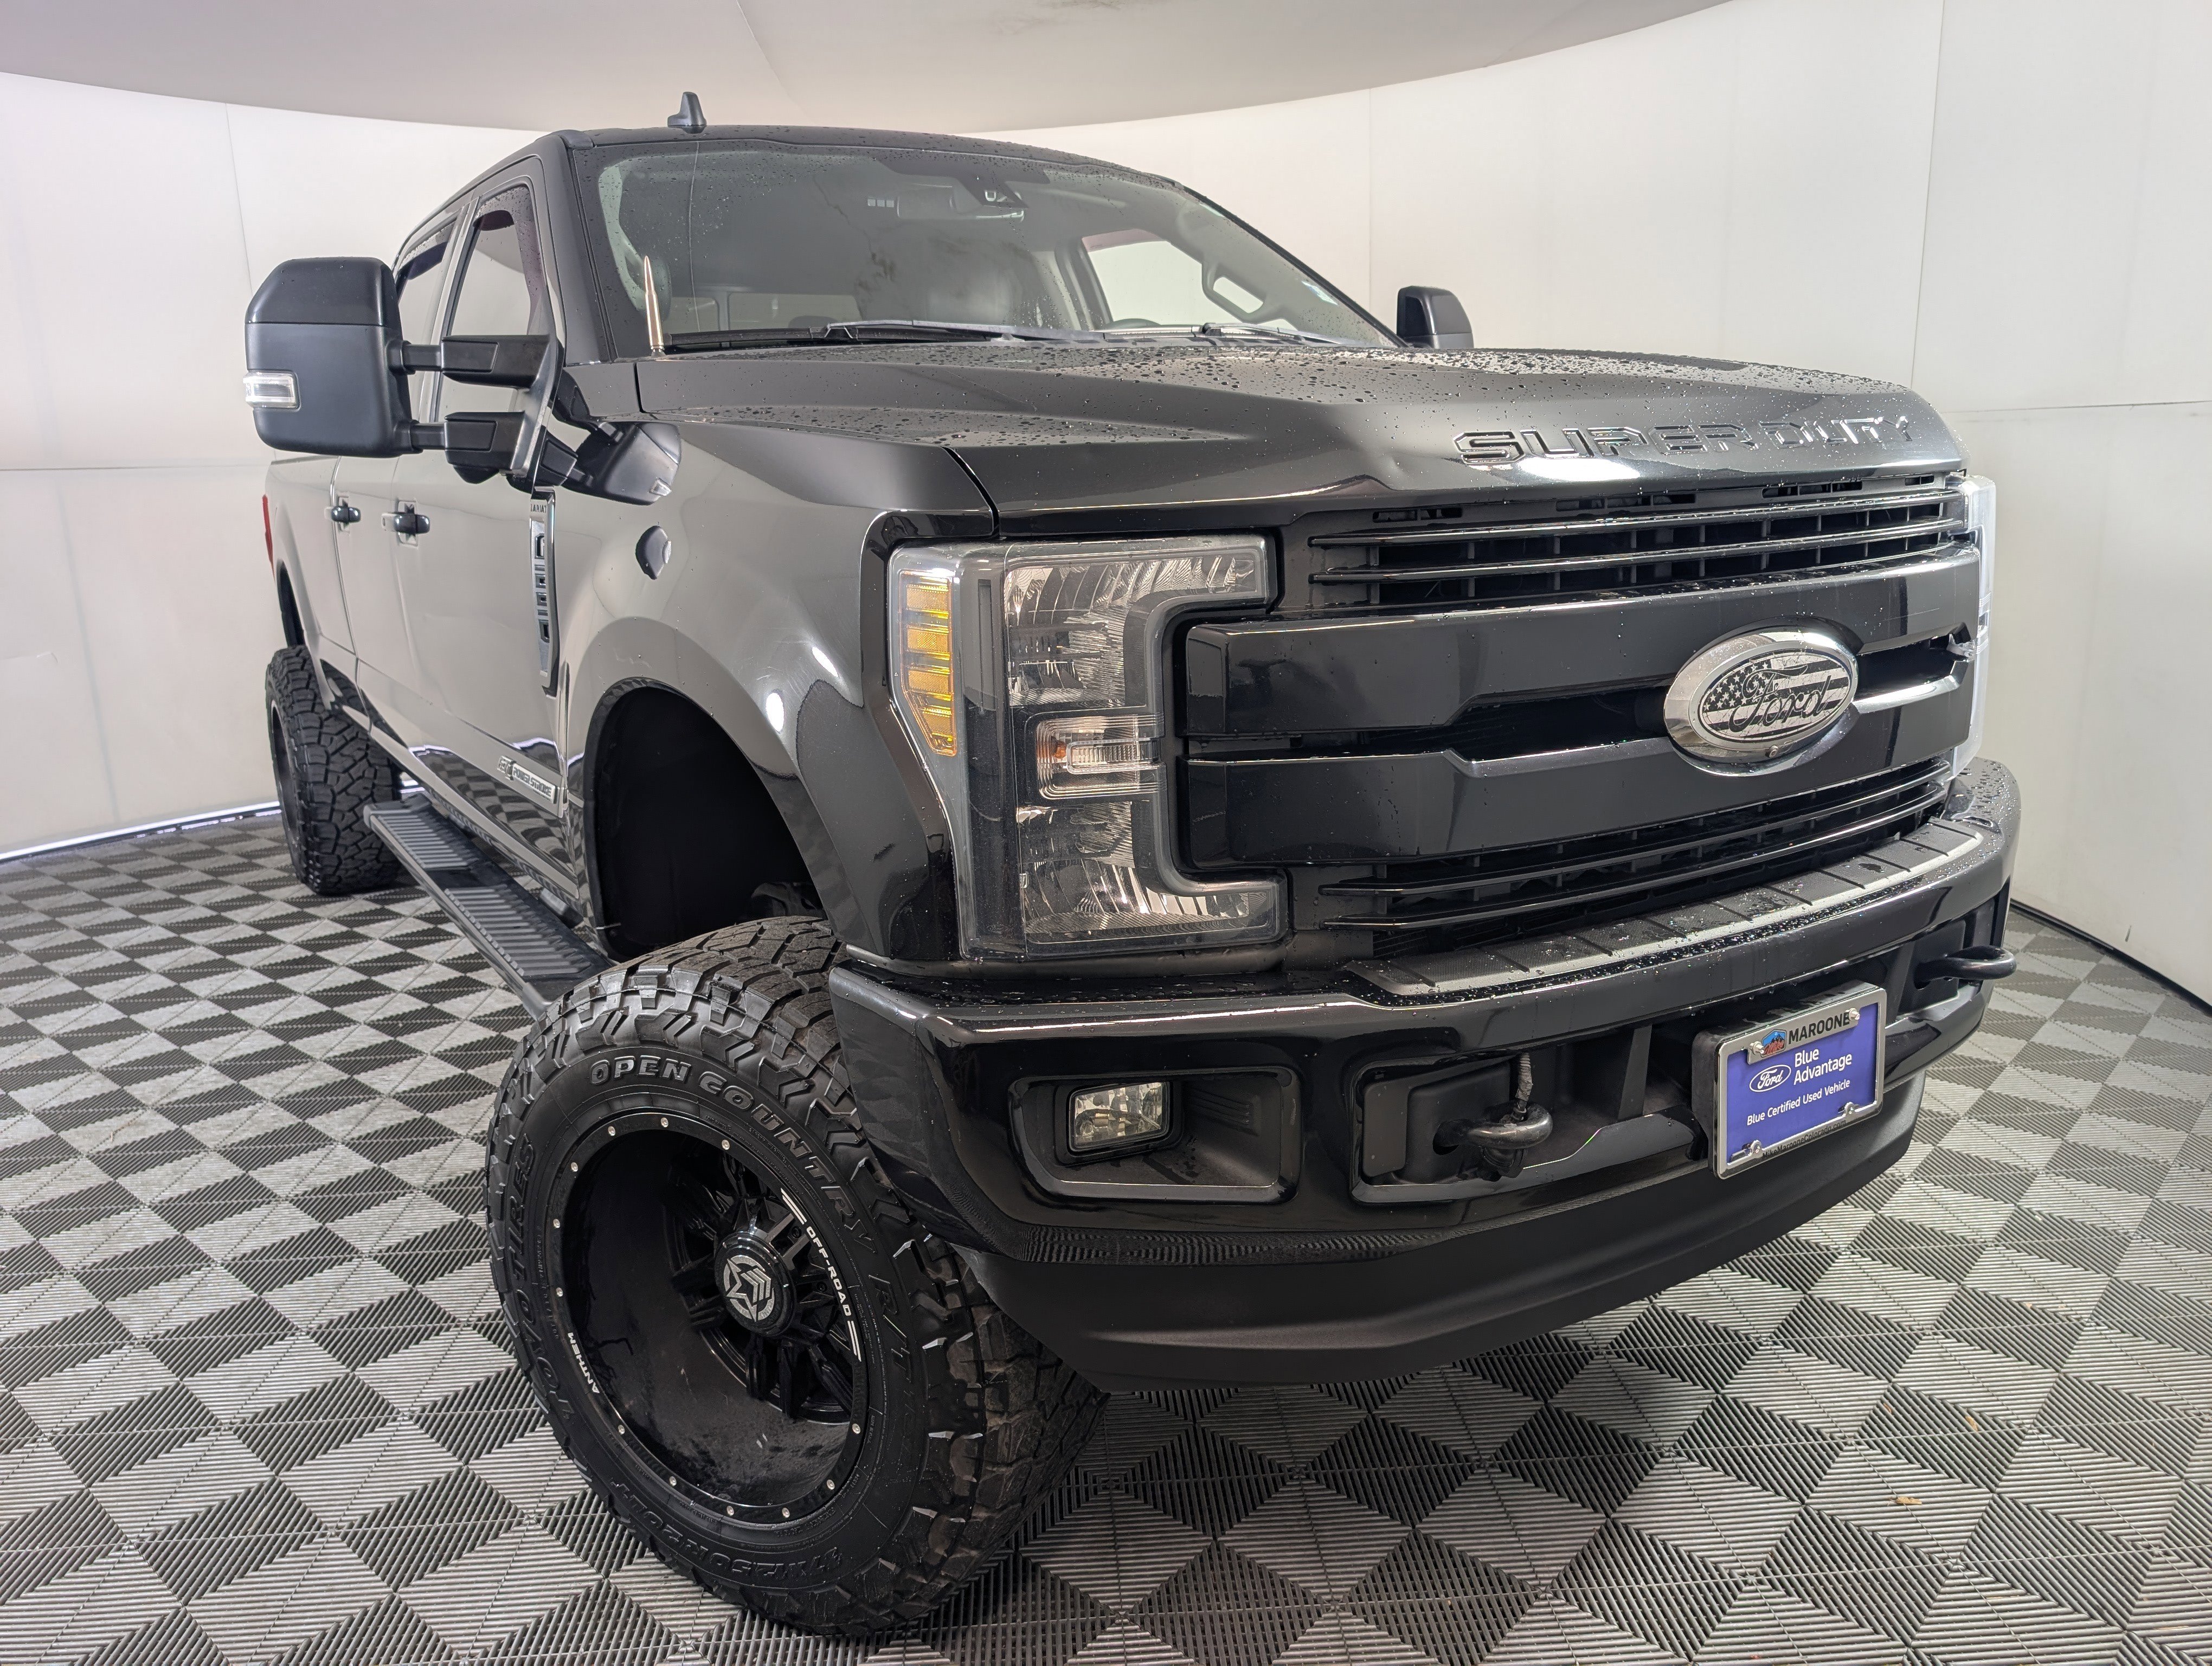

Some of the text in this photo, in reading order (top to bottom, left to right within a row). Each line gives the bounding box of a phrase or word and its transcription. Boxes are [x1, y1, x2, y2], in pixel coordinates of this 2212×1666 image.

[1453, 415, 1912, 464] SUPER DUTY
[530, 504, 546, 512] LARIAT
[1728, 664, 1831, 732] Ford
[1789, 1012, 1850, 1045] MAROONE
[1757, 1069, 1784, 1089] Ford
[1793, 1053, 1852, 1085] Advantage
[1795, 1049, 1819, 1068] Blue
[1747, 1079, 1850, 1126] Blue Certified Used Vehicle
[591, 1055, 691, 1084] OPEN
[699, 1071, 877, 1254] COUNTRY
[1762, 1120, 1847, 1161] MikeMarooneColorado.com
[511, 1133, 536, 1281] TIRES
[806, 1226, 853, 1318] OFF-ROAD
[567, 1332, 601, 1394] ANTHEM
